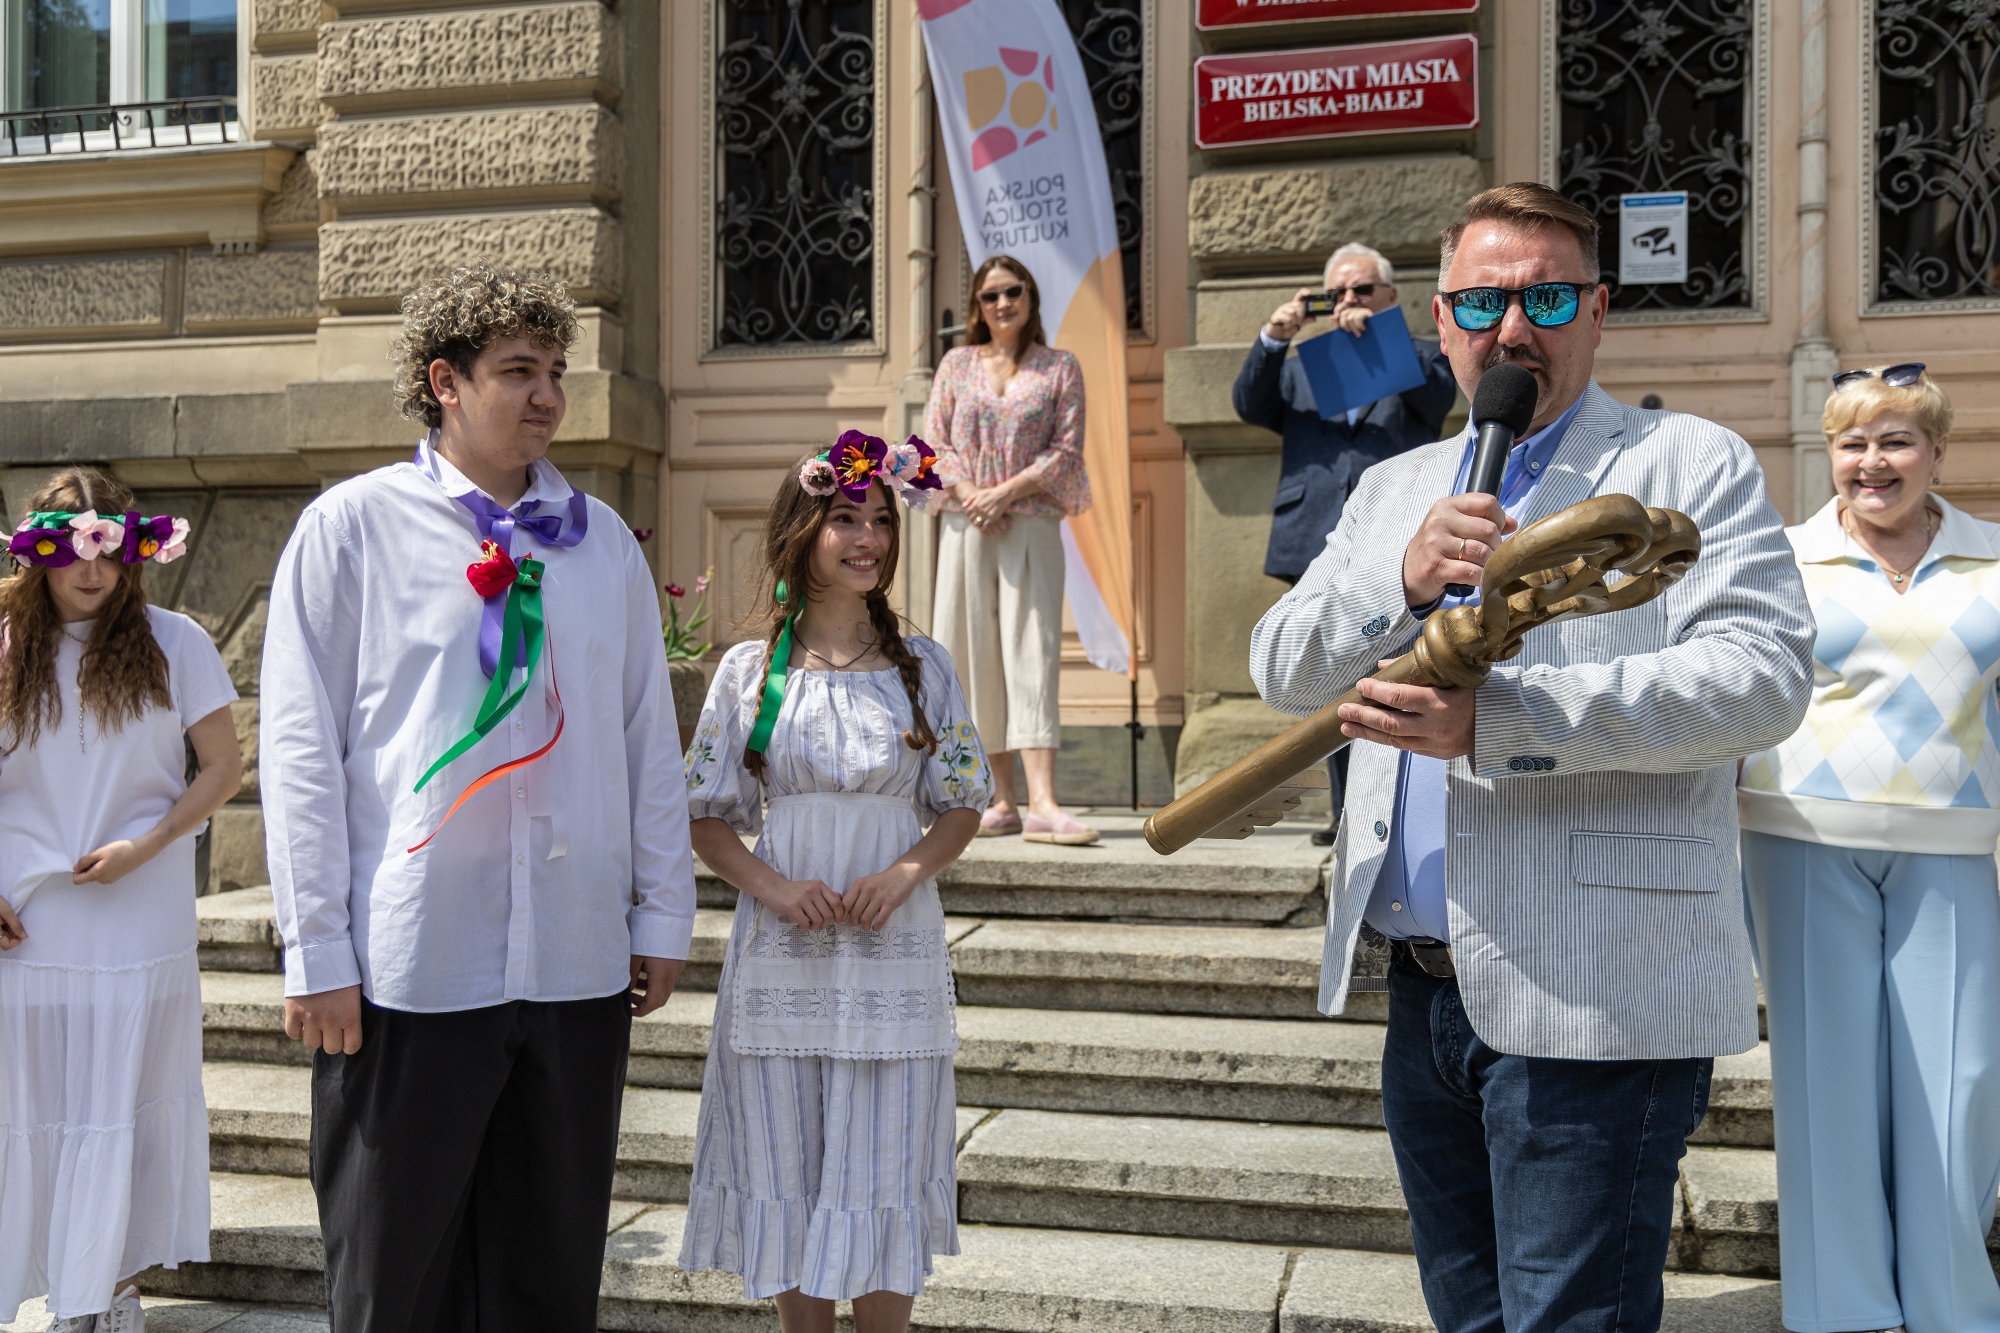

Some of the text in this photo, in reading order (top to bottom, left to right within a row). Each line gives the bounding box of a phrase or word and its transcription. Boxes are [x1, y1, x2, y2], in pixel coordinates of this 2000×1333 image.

[1211, 58, 1461, 102] PREZYDENT MIASTA
[1243, 88, 1425, 123] BIELSKA-BIAŁEJ
